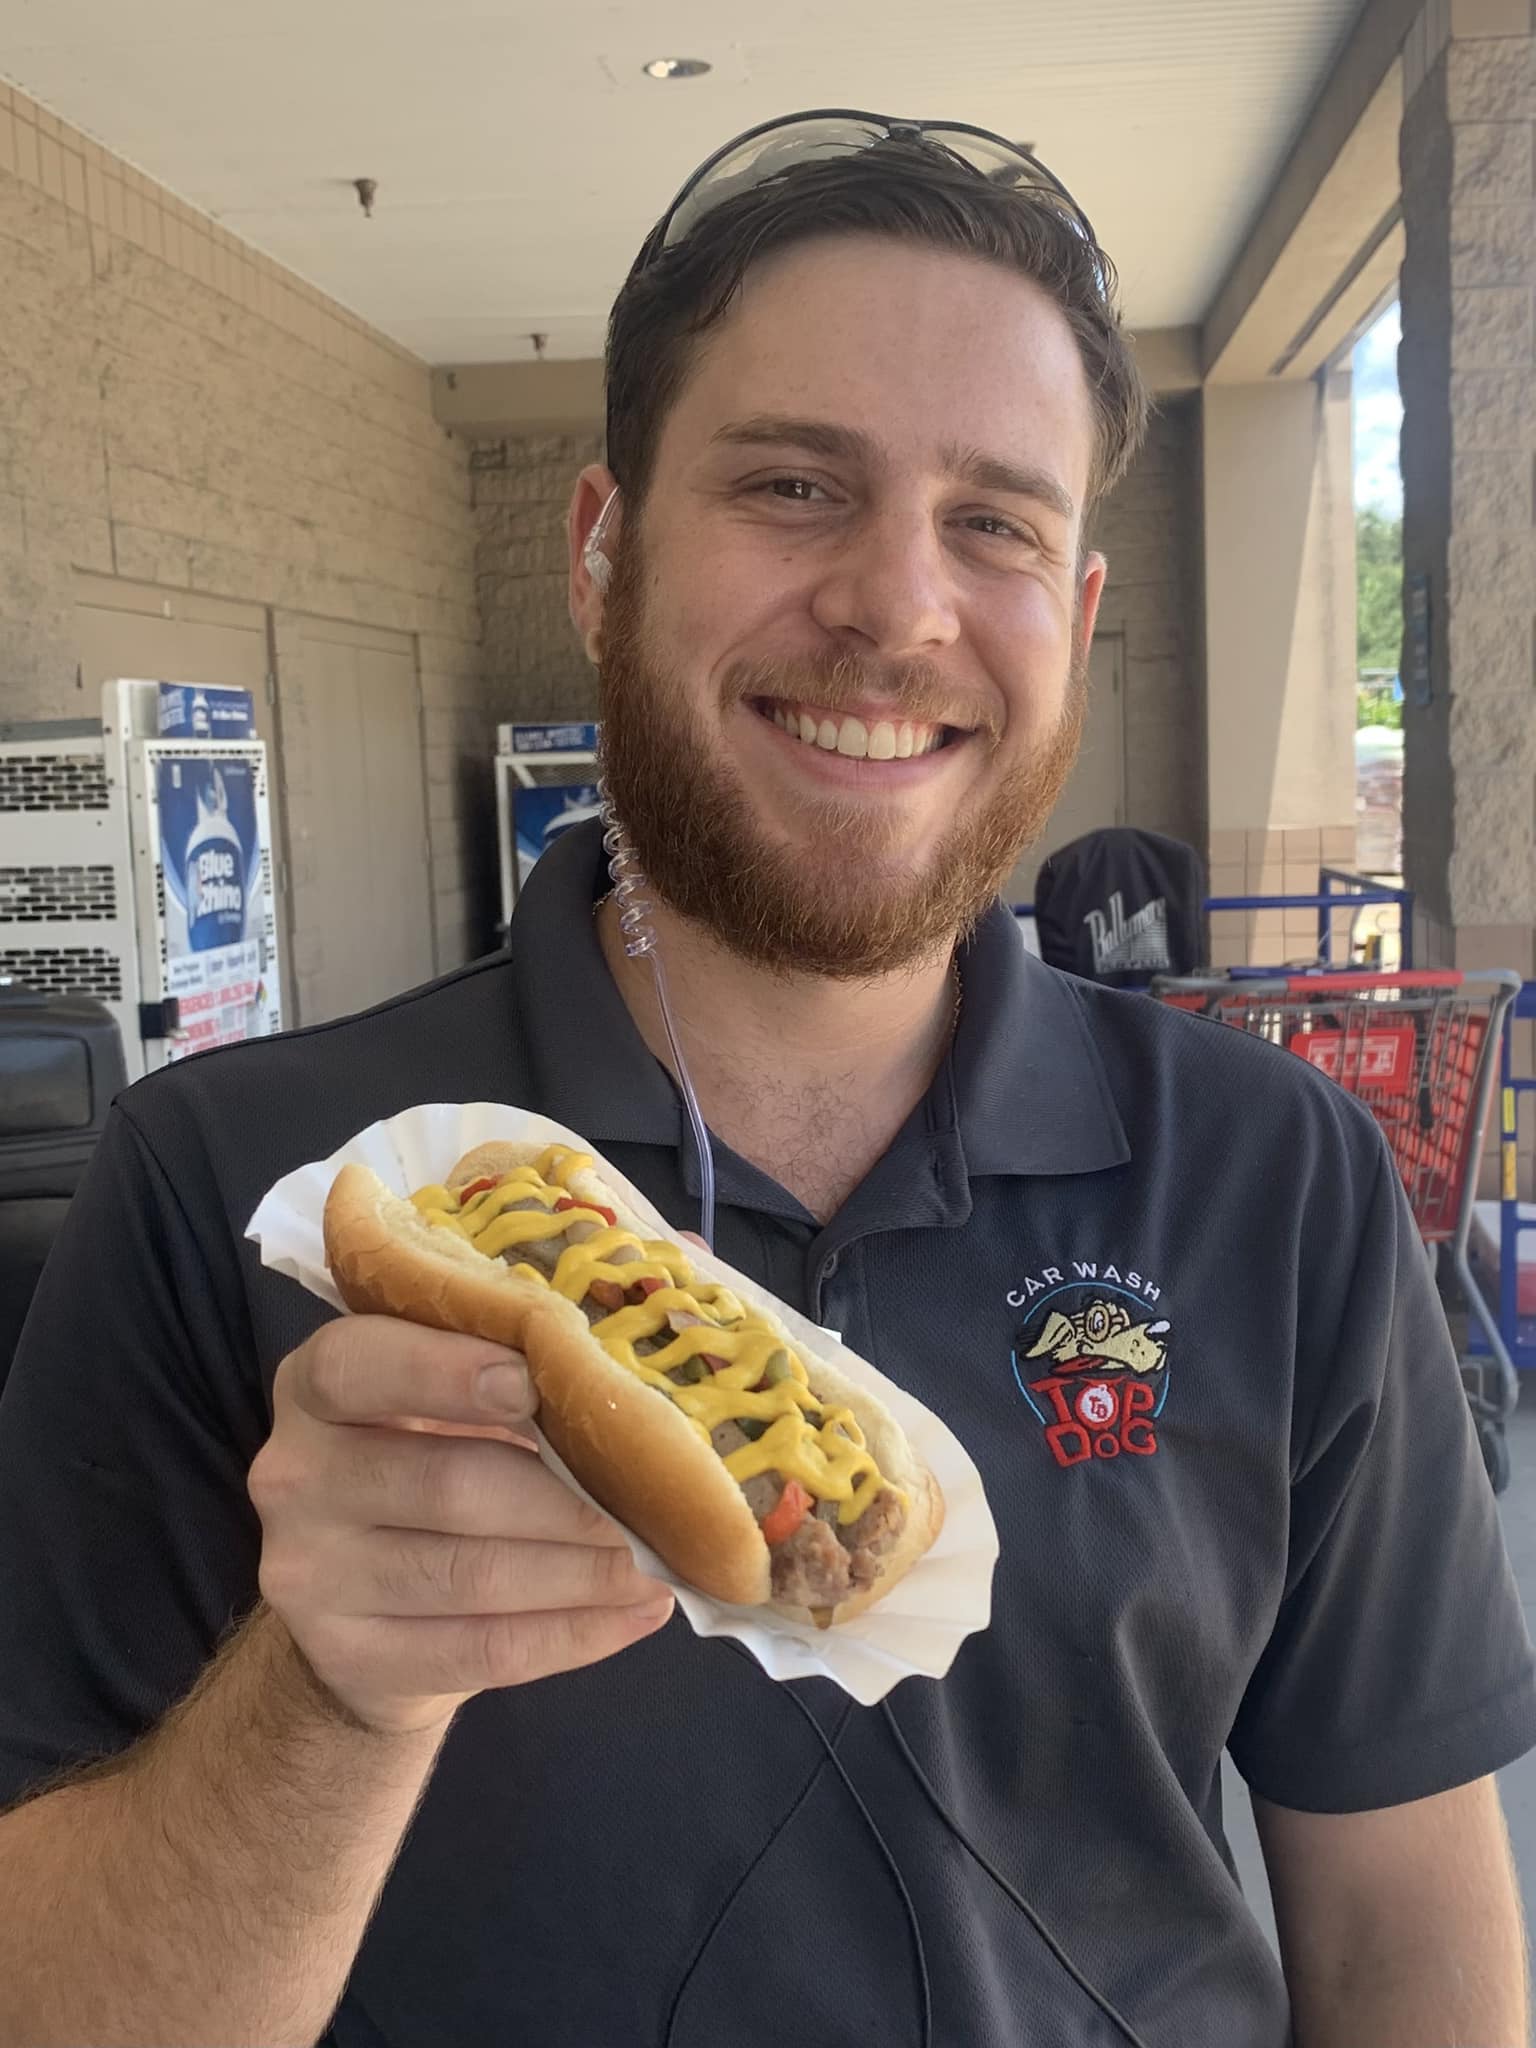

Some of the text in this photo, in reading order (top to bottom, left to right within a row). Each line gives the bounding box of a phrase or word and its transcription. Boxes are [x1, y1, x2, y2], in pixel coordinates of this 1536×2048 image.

[199, 849, 234, 880] Blue
[197, 878, 241, 917] Rhino
[1006, 1261, 1161, 1307] CAR WASH
[1029, 1376, 1155, 1430] TOP
